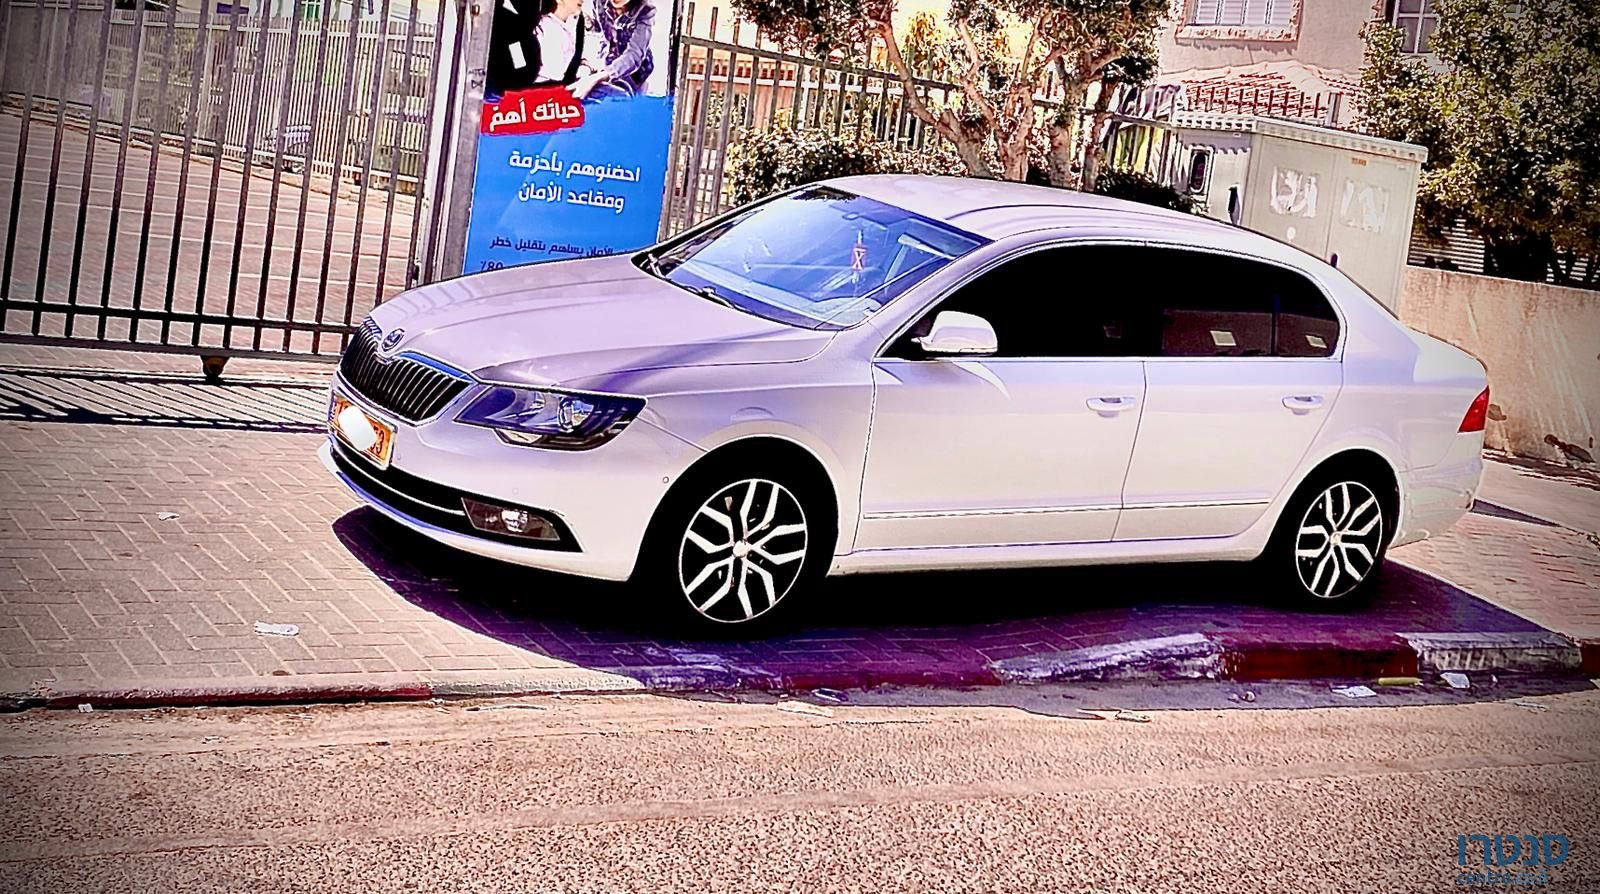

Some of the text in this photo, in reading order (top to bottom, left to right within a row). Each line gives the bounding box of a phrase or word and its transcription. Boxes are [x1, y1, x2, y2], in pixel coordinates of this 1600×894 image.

[509, 150, 641, 183] احضنوهم بأحزمة
[518, 181, 625, 214] ومقاعد الأمان
[489, 236, 512, 249] خطر
